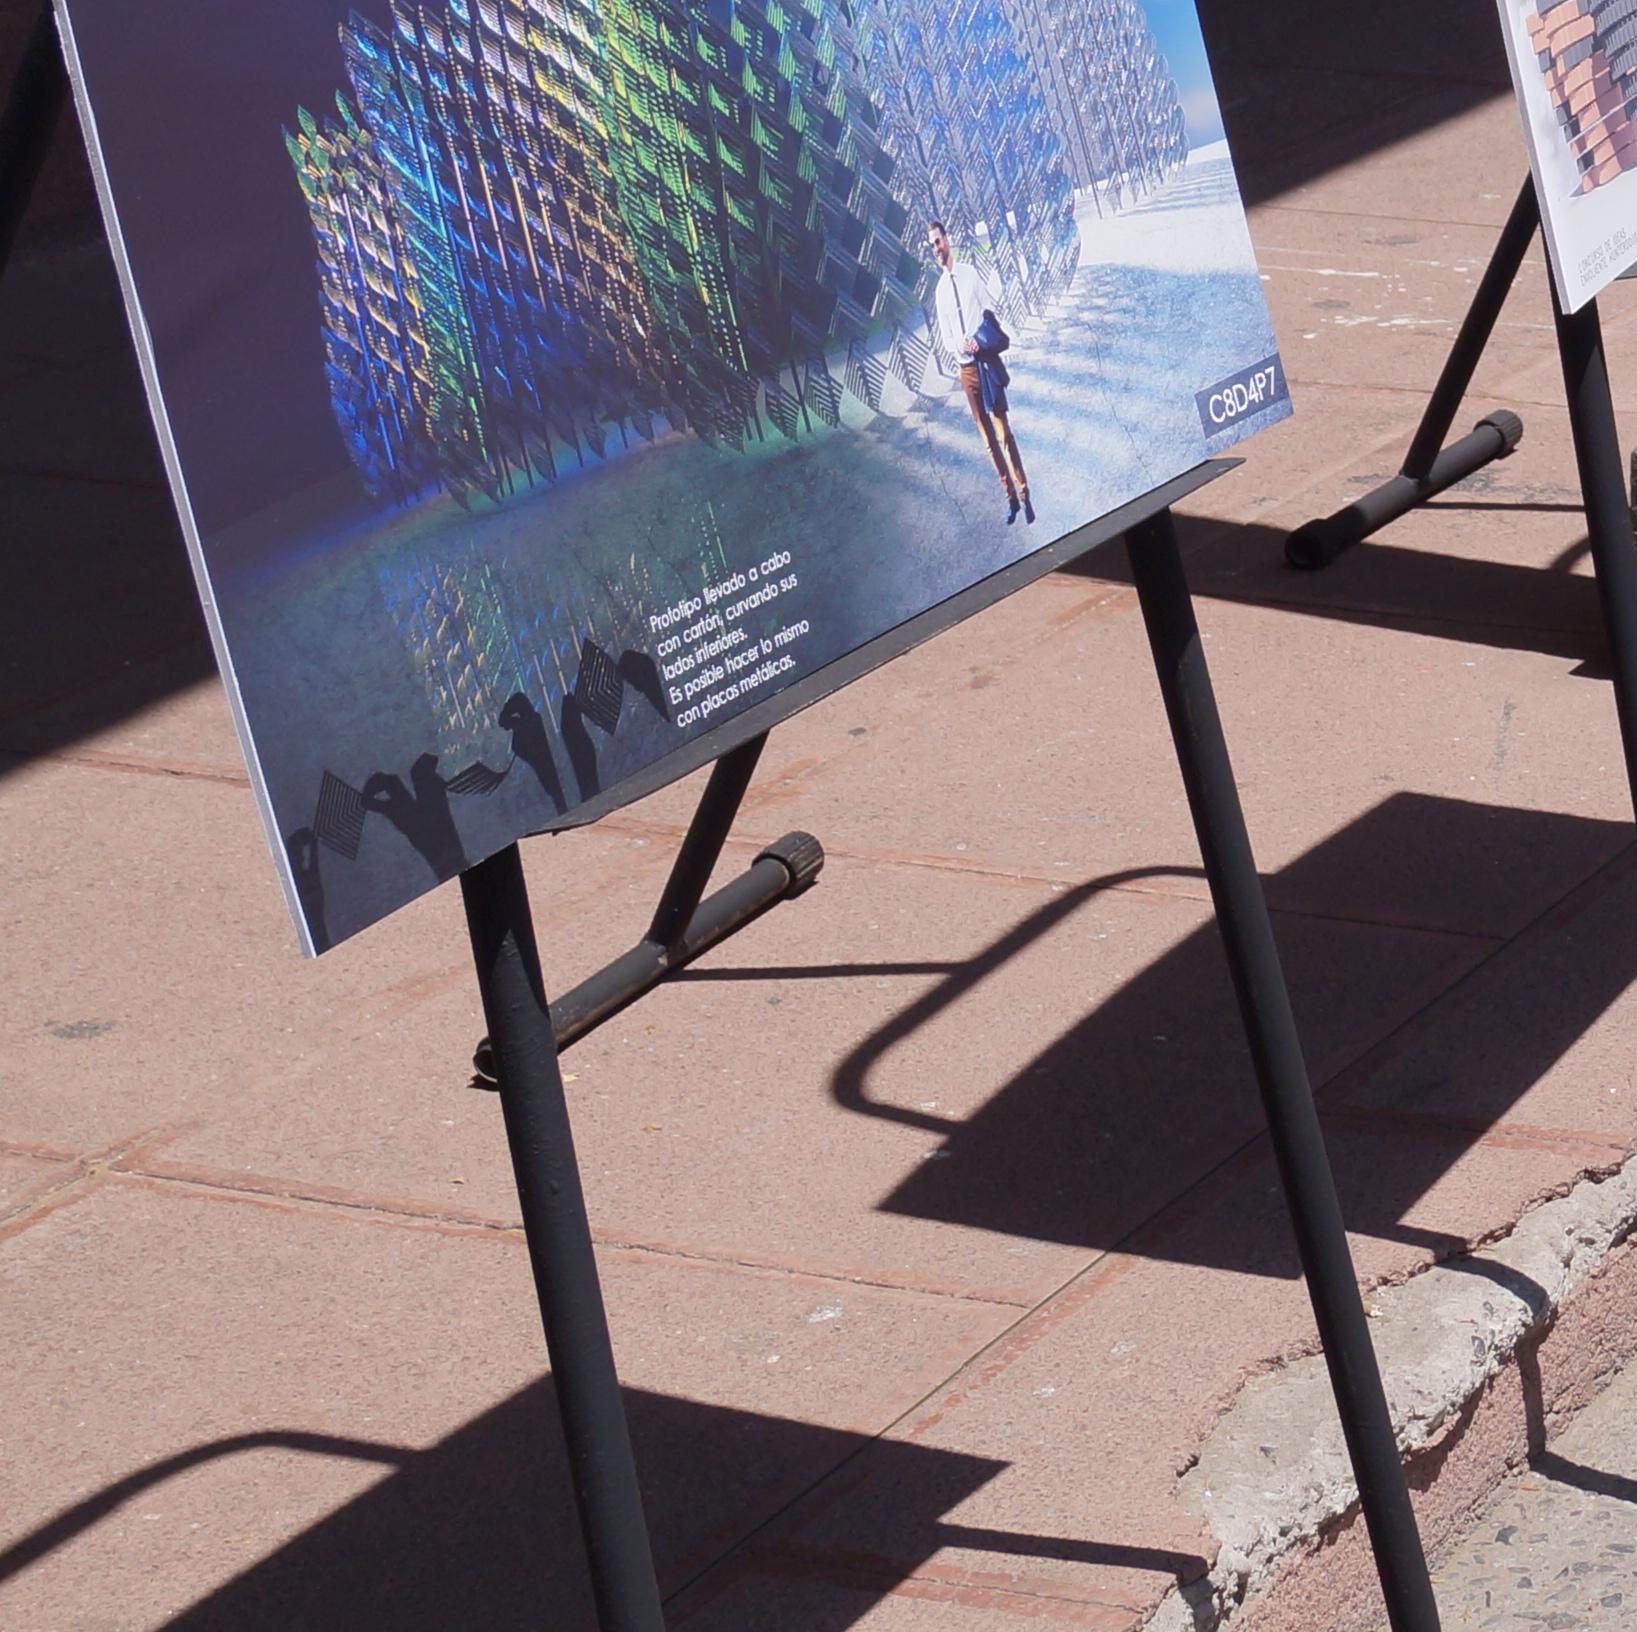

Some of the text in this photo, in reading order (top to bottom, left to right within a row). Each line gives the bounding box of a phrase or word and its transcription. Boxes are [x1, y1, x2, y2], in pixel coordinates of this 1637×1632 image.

[1209, 365, 1275, 423] C8D4P7
[650, 551, 791, 633] Prototipo llevado a cabo
[657, 572, 798, 657] con cartón, curvando sus
[662, 627, 748, 681] lados inferiores.
[668, 620, 810, 705] Es posible hacer lo mismo
[677, 653, 796, 728] con placas metálicas.
